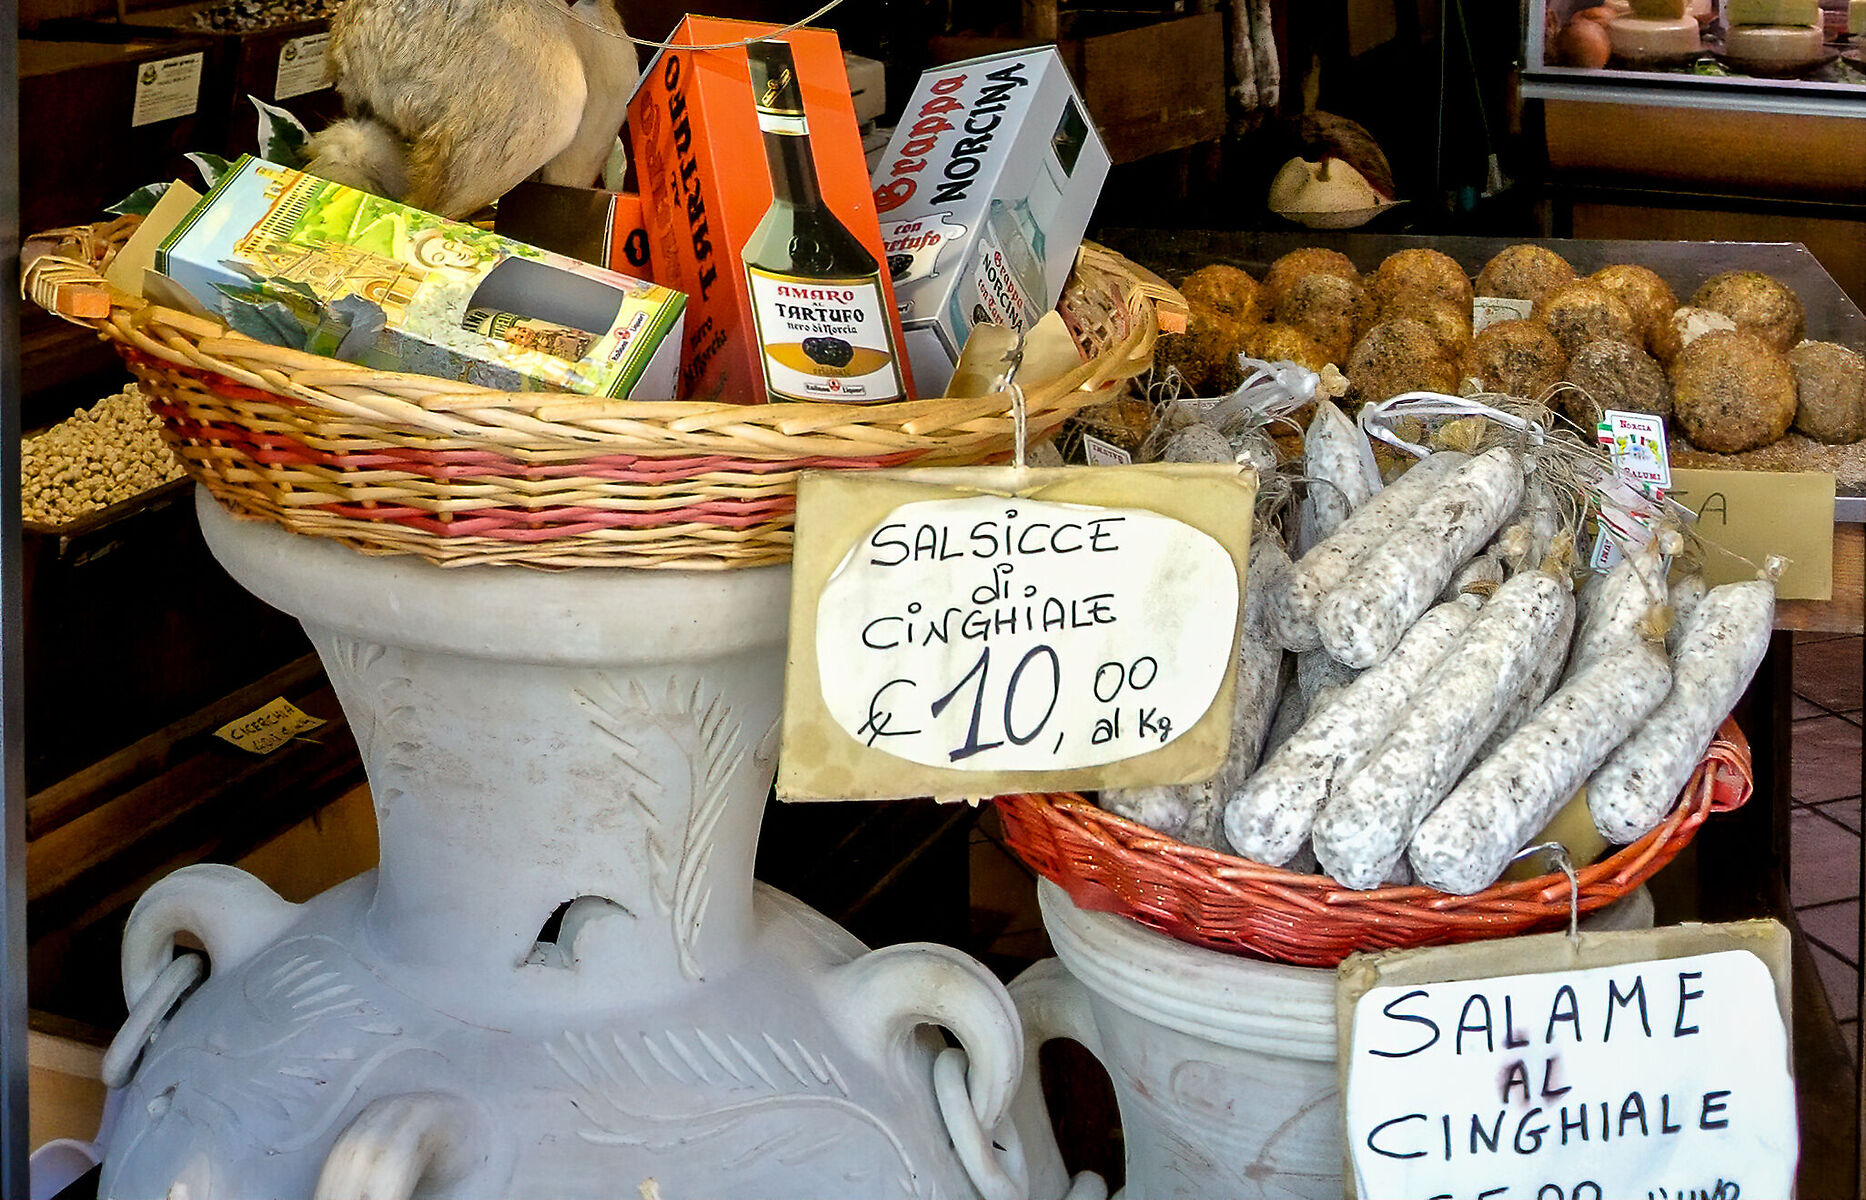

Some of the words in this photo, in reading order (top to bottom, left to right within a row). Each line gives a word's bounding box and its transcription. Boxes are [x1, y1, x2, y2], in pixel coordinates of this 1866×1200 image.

[929, 62, 1029, 206] NORCINA
[664, 55, 718, 302] TARTUFO
[894, 222, 923, 235] con
[775, 303, 865, 323] TARTUFO
[777, 286, 855, 305] AMARO
[983, 253, 1023, 334] NORCINA
[787, 321, 810, 332] nero
[824, 323, 858, 336] Norcia
[972, 563, 1015, 606] di
[1091, 707, 1120, 745] al
[1368, 971, 1706, 1058] SALAME
[1502, 1056, 1573, 1105] AL
[1366, 1090, 1733, 1162] CINGHIALE
